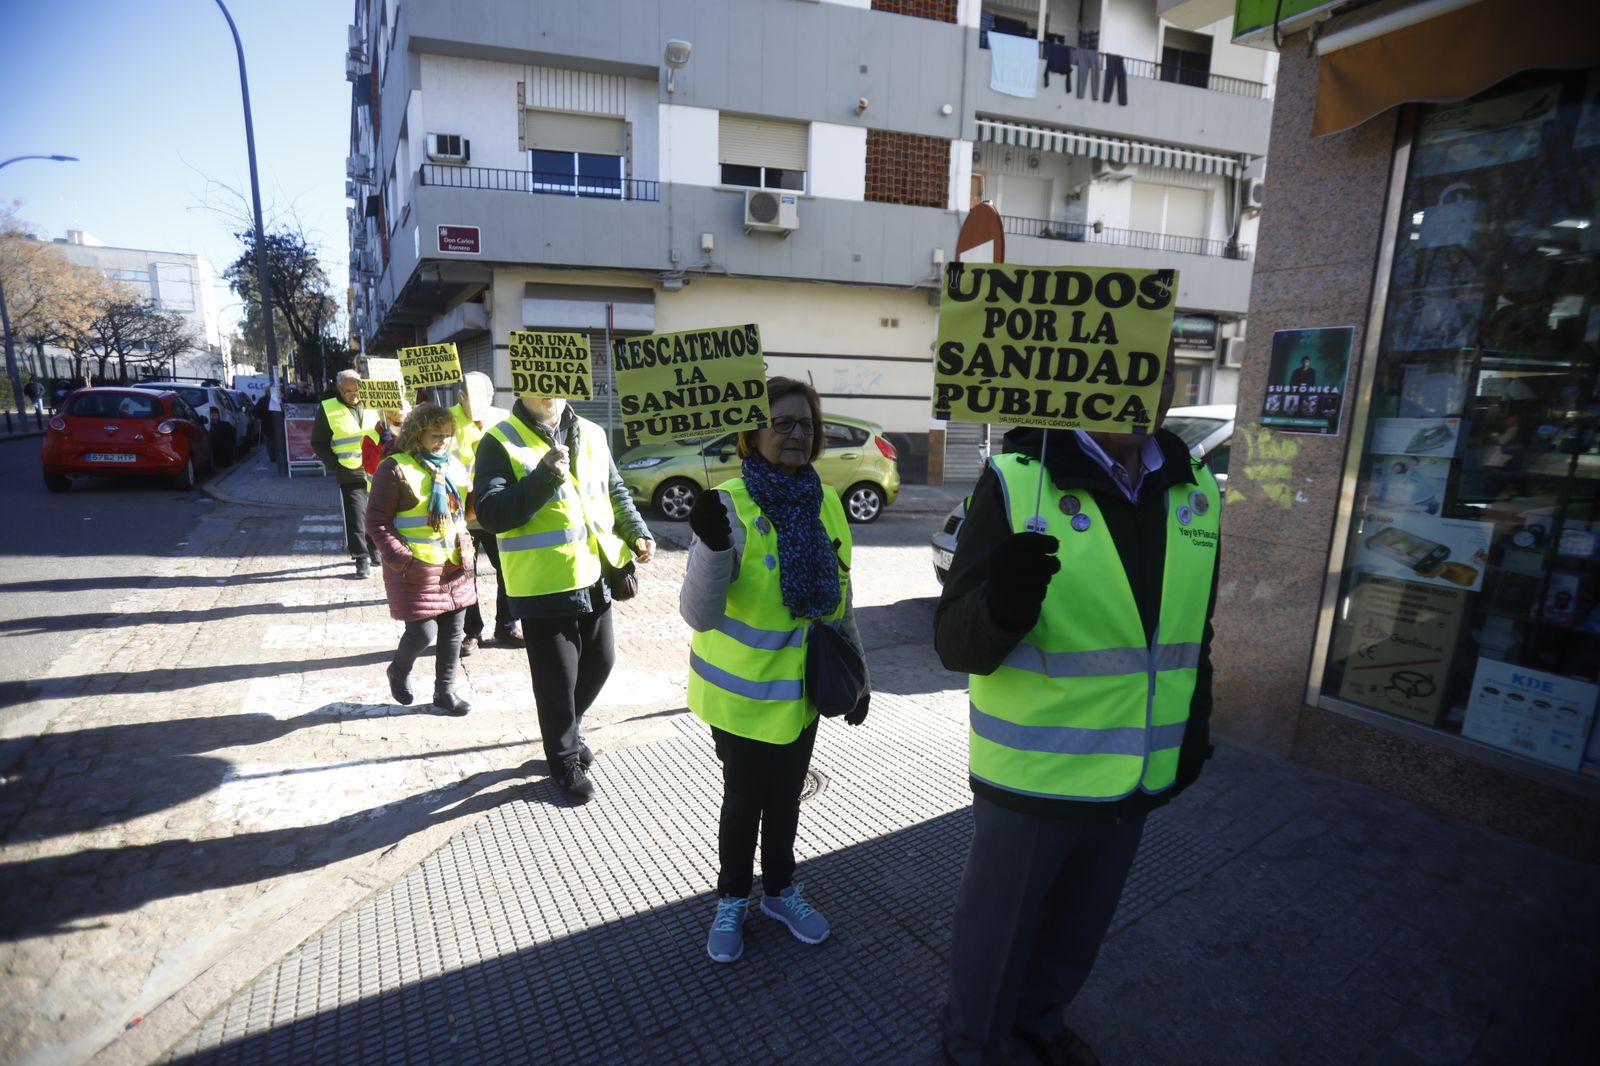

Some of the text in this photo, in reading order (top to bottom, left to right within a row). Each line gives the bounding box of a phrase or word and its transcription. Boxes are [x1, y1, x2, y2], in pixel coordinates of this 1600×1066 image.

[947, 267, 1174, 310] UNIDOS
[983, 307, 1119, 345] POR LA
[518, 334, 577, 347] POR UNA
[613, 326, 759, 371] RESCATEMOS
[400, 353, 457, 367] ESPECULADORES
[406, 345, 448, 358] FUERA
[509, 345, 588, 360] SANIDAD
[419, 363, 442, 373] DE LA
[510, 356, 588, 374] PÚBLICA
[937, 341, 1161, 387] SANIDAD
[358, 381, 399, 390] NO AL CIERRE
[404, 369, 461, 385] SANIDAD
[512, 373, 590, 395] DIGNA
[674, 366, 707, 386] LA
[360, 391, 401, 399] DE SERVICIOS
[371, 400, 403, 408] CAMAS
[621, 379, 765, 416] SANIDAD
[935, 379, 1151, 423] PÚBLICA
[624, 404, 768, 439] PÚBLICA
[1511, 673, 1554, 693] KDE
